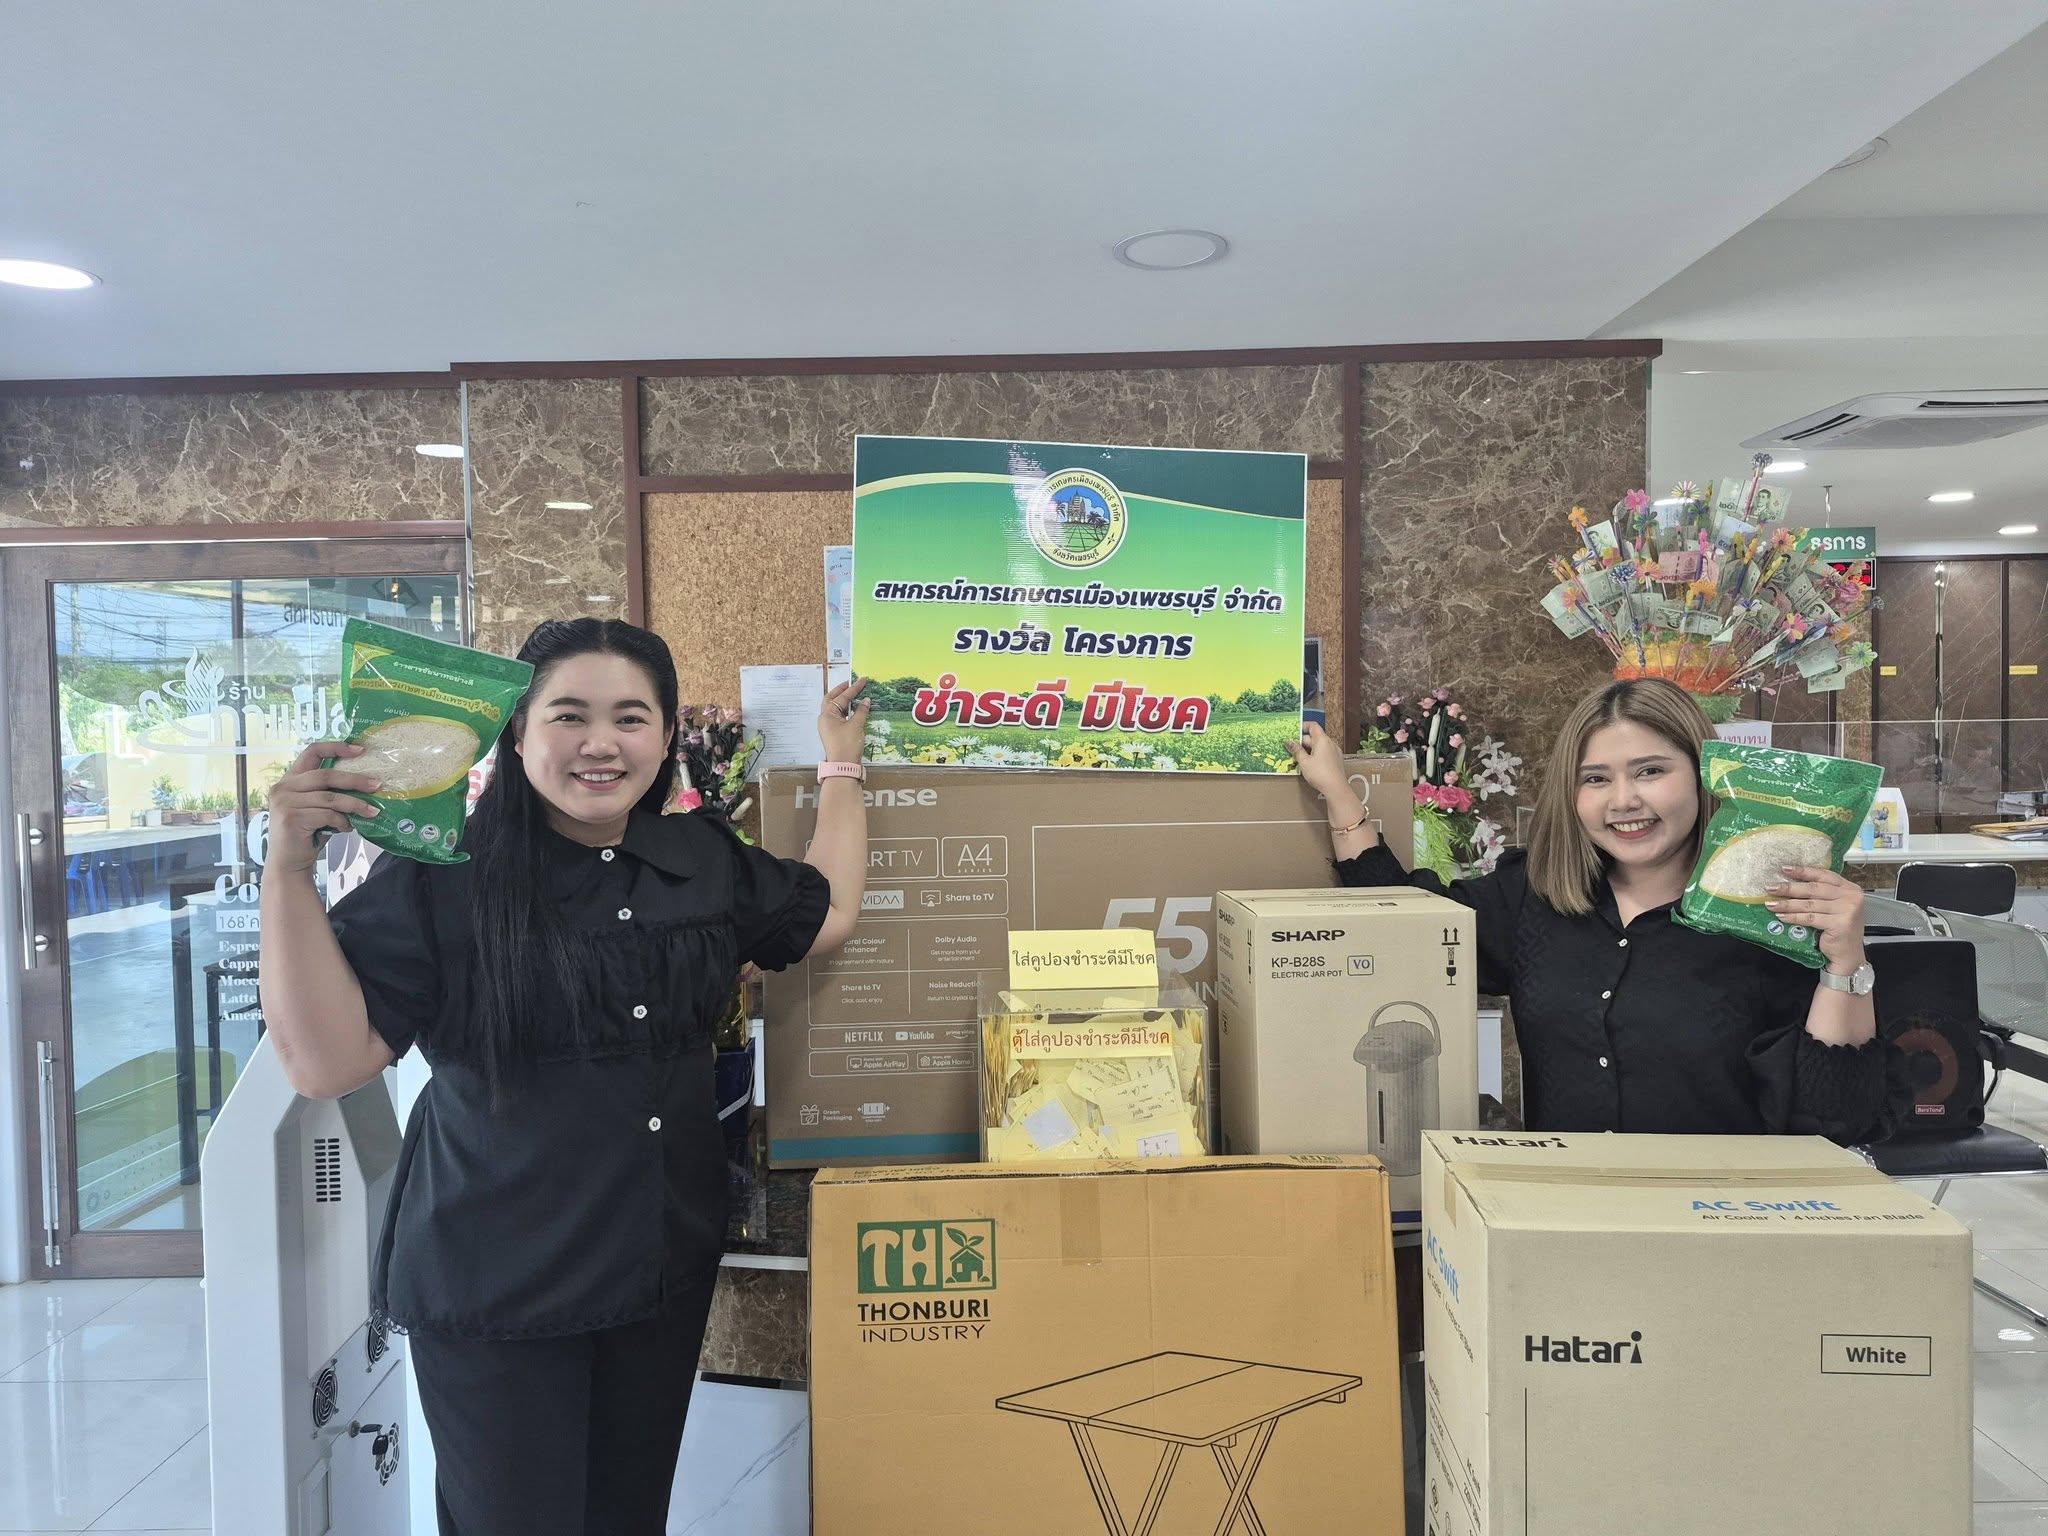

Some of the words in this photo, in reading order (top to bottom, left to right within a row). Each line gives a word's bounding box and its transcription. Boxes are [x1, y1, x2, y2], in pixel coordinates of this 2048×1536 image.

[875, 579, 1217, 615] สหกรณ์การเกษตรเมืองเพชรบุรี
[1224, 587, 1283, 611] จำกัด
[954, 623, 1051, 652] รางวัล
[1064, 626, 1193, 657] โครงการ
[229, 680, 266, 701] ร้าน
[912, 673, 1068, 728] ชำระดี
[1080, 680, 1211, 732] มีโชค
[795, 785, 938, 809] Hense
[214, 811, 270, 867] 16
[901, 850, 923, 867] TV
[958, 844, 993, 867] A4
[945, 894, 971, 902] Share
[983, 893, 995, 901] TV
[935, 936, 955, 945] Dolby
[1271, 929, 1346, 943] SHARP
[219, 940, 260, 955] Espre
[218, 958, 260, 972] Cappu
[1012, 949, 1156, 972] ใส่คูปองชำระดีมีโชค
[1271, 956, 1326, 968] KP-B28S
[1353, 959, 1371, 969] VO
[1271, 971, 1309, 979] ELECTRIC
[1310, 970, 1326, 978] JAR
[1327, 969, 1343, 977] POT
[841, 984, 862, 992] Share
[872, 983, 882, 991] TV
[221, 992, 258, 1004] Latte
[219, 1009, 264, 1021] Ameri
[845, 1031, 884, 1043] NETFLIX
[908, 1031, 935, 1040] YouTube
[1012, 1027, 1170, 1054] ตู้ใส่คูปองชำระดีมีโชค
[863, 1061, 883, 1069] Apple
[883, 1060, 906, 1068] AirPlay
[1452, 1136, 1568, 1148] Hatari
[1692, 1200, 1739, 1211] AC
[1743, 1200, 1842, 1211] Swift
[1427, 1227, 1438, 1265] AC
[1439, 1247, 1459, 1305] Swift
[857, 1298, 989, 1322] THONBURI
[862, 1324, 986, 1343] INDUSTRY
[1525, 1330, 1643, 1364] Hatari
[1846, 1346, 1907, 1364] White
